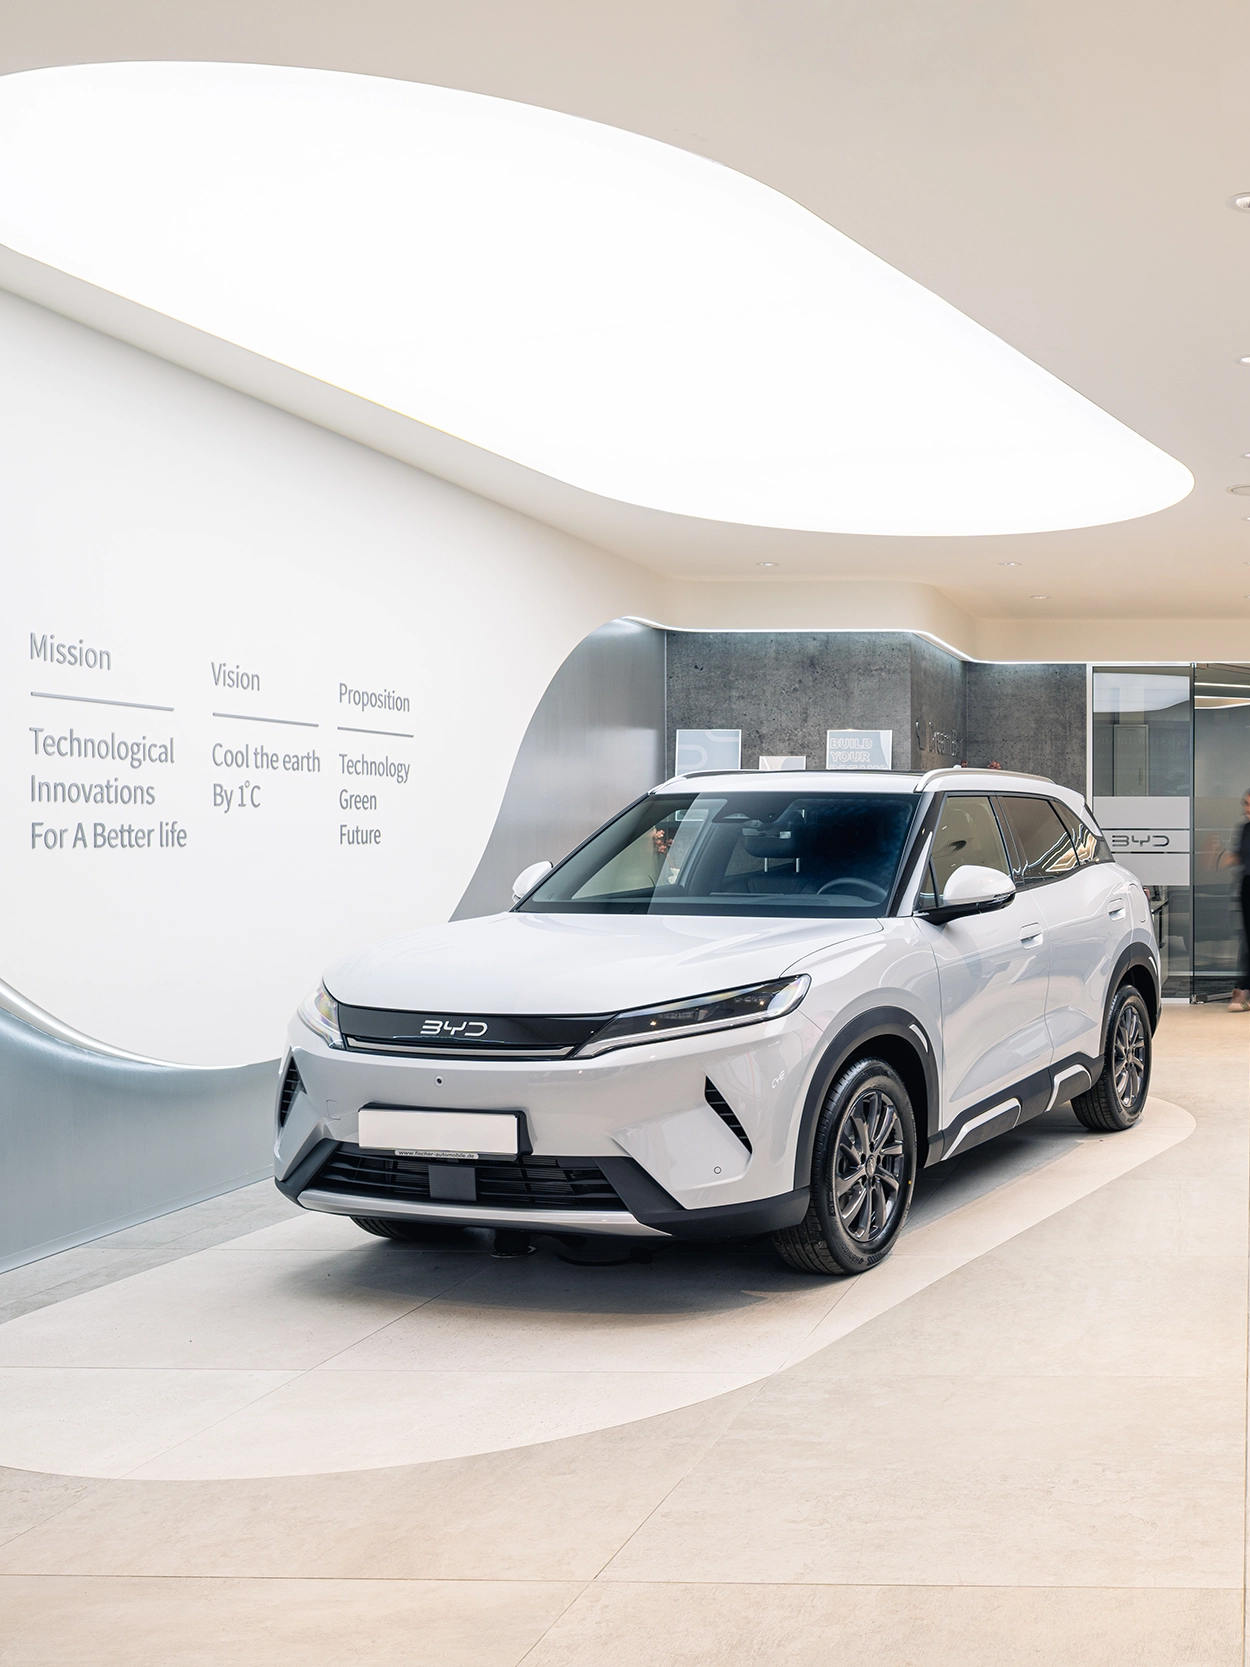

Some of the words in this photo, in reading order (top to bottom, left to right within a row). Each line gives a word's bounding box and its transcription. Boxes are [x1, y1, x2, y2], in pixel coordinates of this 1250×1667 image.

[30, 632, 110, 670] Mission
[210, 661, 260, 692] Vision
[339, 682, 410, 713] Proposition
[29, 727, 175, 769] Technological
[213, 742, 250, 769] Cool
[253, 744, 280, 771] the
[282, 749, 321, 773] earth
[830, 738, 873, 750] BUILD
[830, 751, 870, 762] YOUR
[339, 753, 411, 784] Technology
[31, 774, 156, 806] Innovations
[213, 783, 234, 814] By
[339, 788, 377, 811] Green
[31, 822, 69, 850] For
[72, 822, 88, 849] A
[93, 822, 155, 849] Better
[159, 820, 188, 848] life
[339, 824, 382, 846] Future
[1112, 835, 1170, 847] BYD
[420, 1019, 488, 1037] BYD
[398, 1150, 475, 1159] www.fischer-automobile.de
